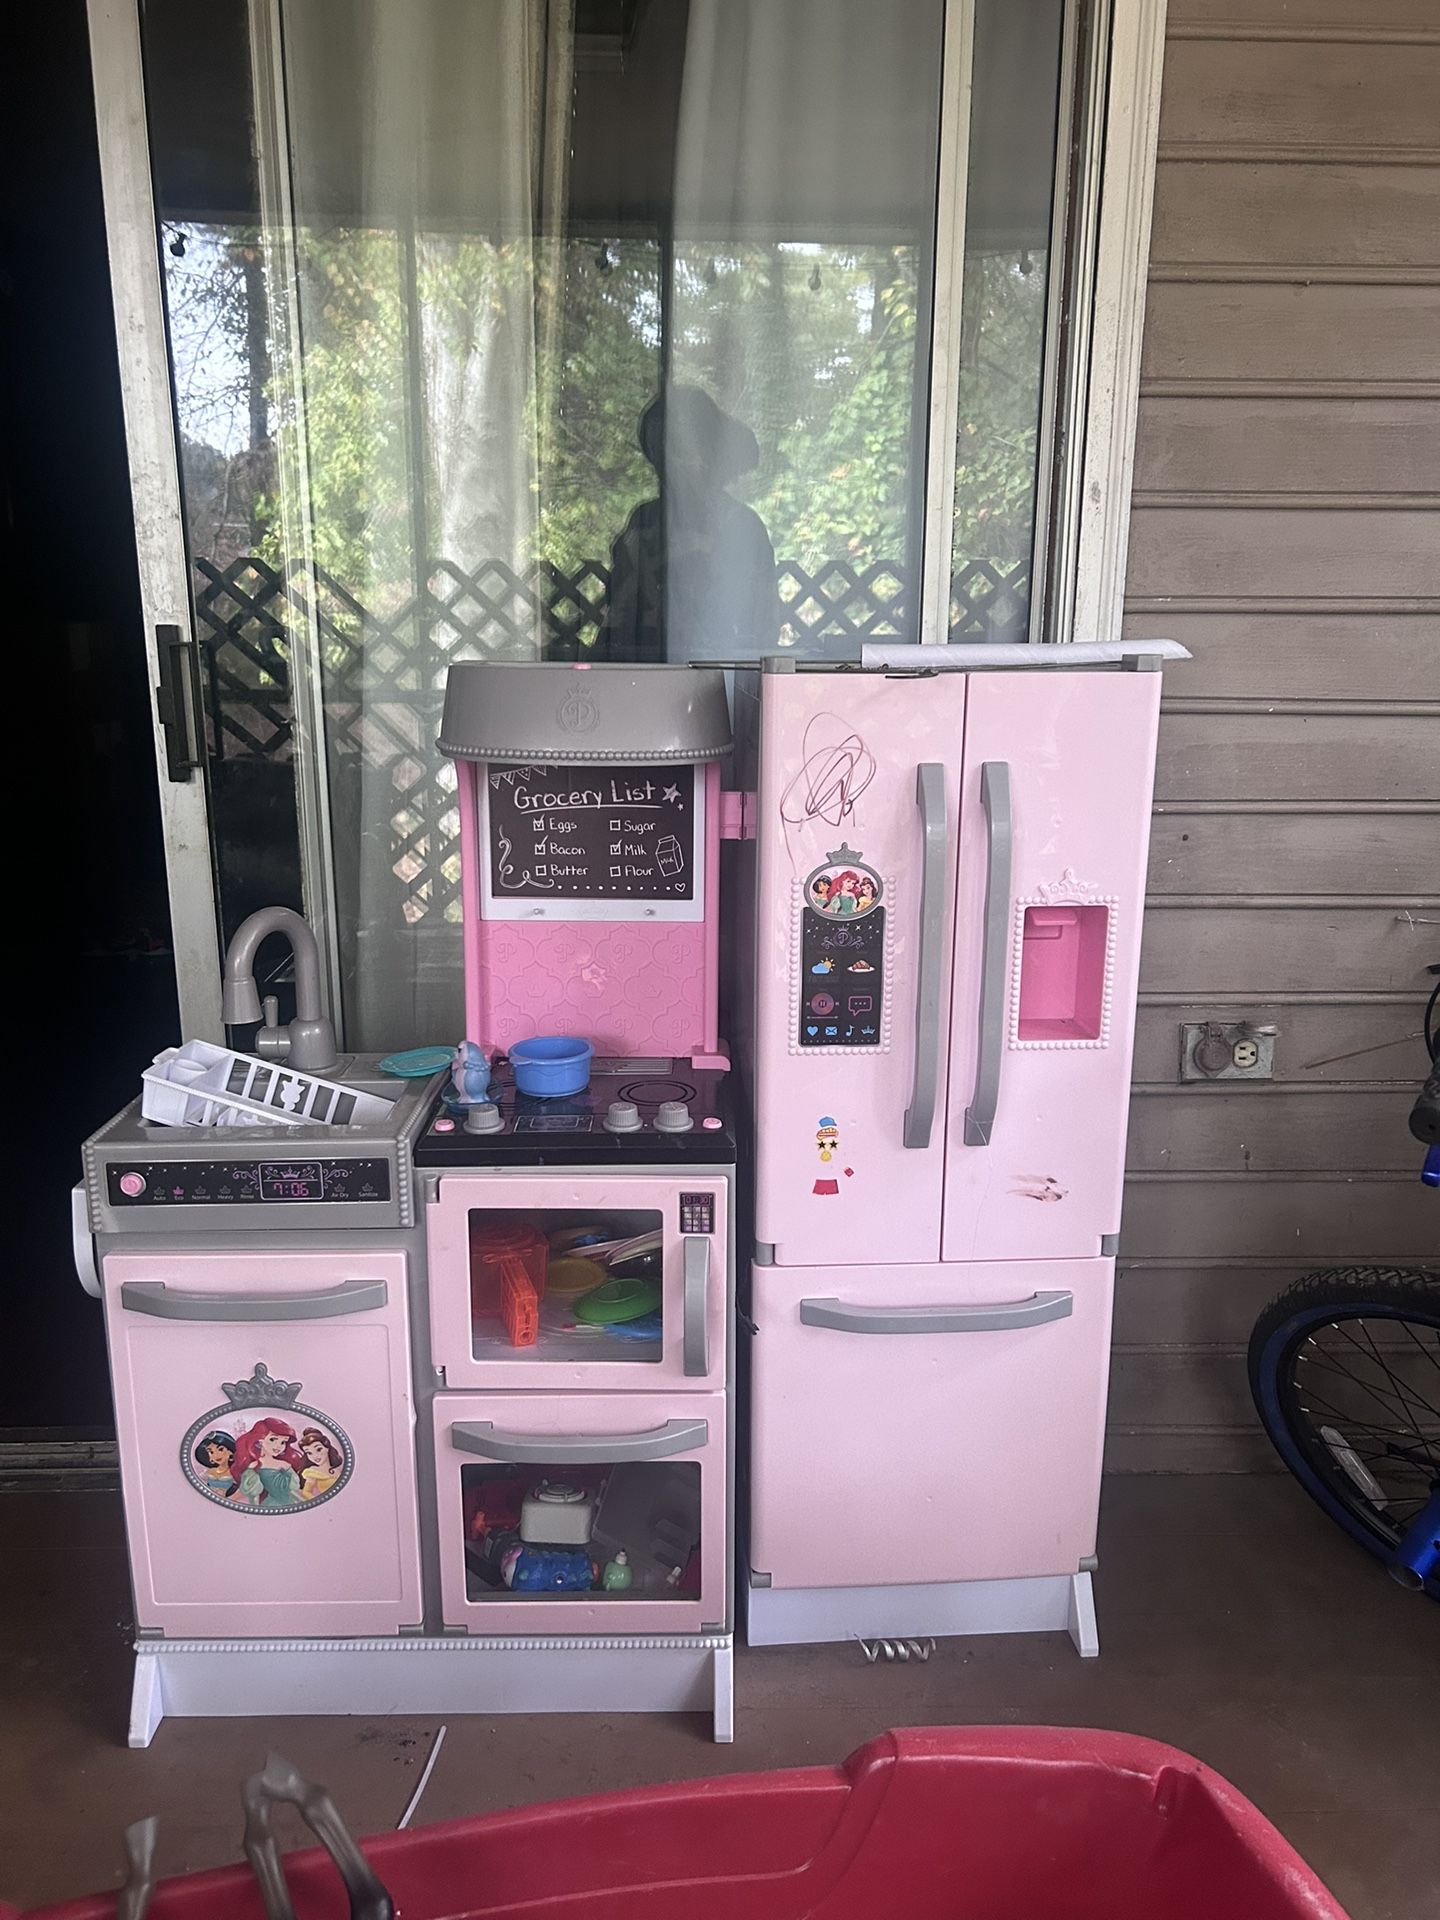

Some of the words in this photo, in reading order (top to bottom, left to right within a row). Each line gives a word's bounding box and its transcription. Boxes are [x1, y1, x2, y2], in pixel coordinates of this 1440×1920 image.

[514, 786, 603, 809] Grocery
[611, 779, 656, 803] List
[550, 817, 578, 833] Eggs
[624, 819, 656, 835] Sugar
[550, 840, 586, 855] Bacon
[624, 843, 647, 856] Milk
[551, 865, 589, 876] Butter
[624, 865, 655, 876] Flour
[273, 1182, 309, 1197] 7:06
